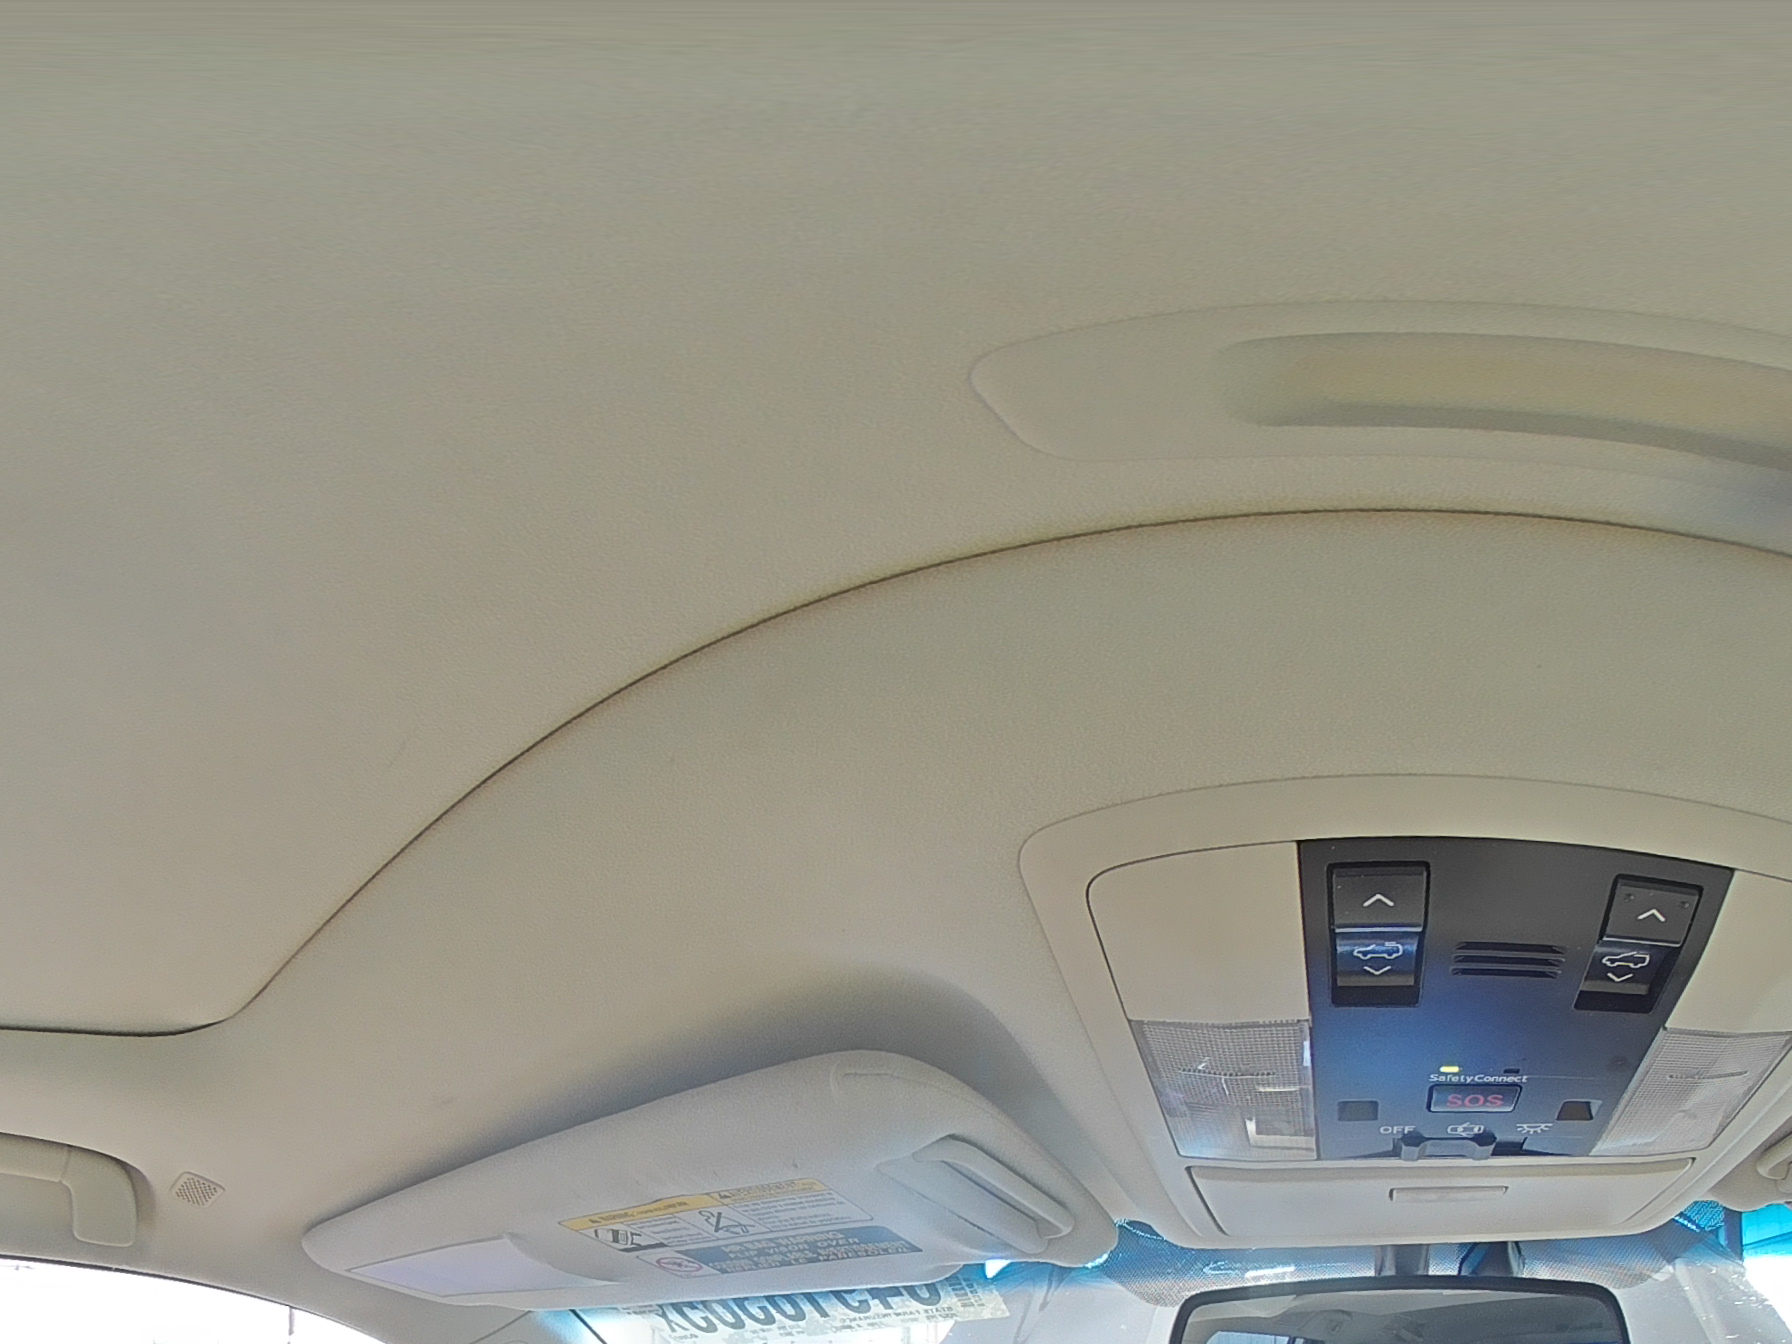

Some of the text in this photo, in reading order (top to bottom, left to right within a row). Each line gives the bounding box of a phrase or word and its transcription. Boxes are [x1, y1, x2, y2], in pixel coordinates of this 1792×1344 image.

[1445, 1094, 1505, 1108] SOS
[1379, 1125, 1416, 1134] OFF
[766, 1244, 809, 1255] VISOR
[816, 1237, 861, 1248] OVER
